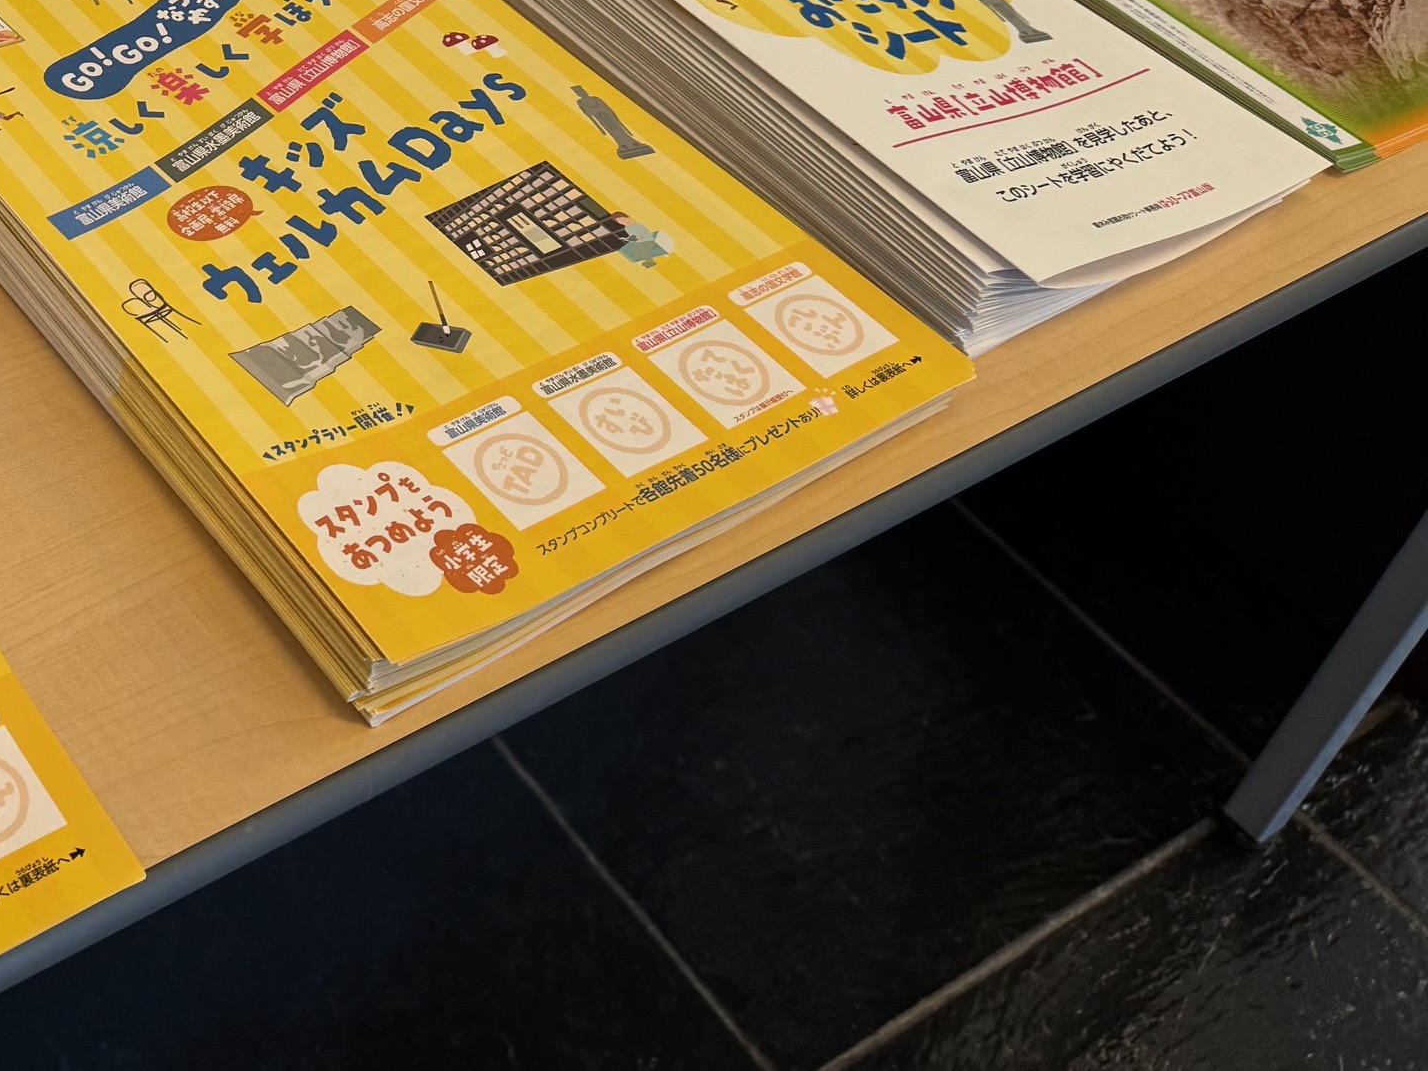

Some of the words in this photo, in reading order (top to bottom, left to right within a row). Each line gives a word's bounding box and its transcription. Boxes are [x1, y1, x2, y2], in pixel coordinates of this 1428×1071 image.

[61, 23, 173, 93] GO!GO!
[852, 9, 968, 60] シート
[887, 58, 1103, 130] 富山県[立山博物館]
[172, 111, 261, 172] 富山県水墨美術館
[239, 92, 366, 193] キッズ
[996, 129, 1198, 203] このシートを学習にやくだてよう!
[75, 185, 148, 226] 富山県美術館
[202, 73, 527, 304] ウェルカムDays
[270, 403, 403, 457] スタンプラリー開催!
[445, 405, 506, 439] 富山県美術館
[503, 445, 544, 494] TAD
[315, 472, 421, 539] スタンプを
[341, 495, 453, 570] あつめよう
[444, 534, 493, 570] 小学生
[467, 554, 509, 587] 限定
